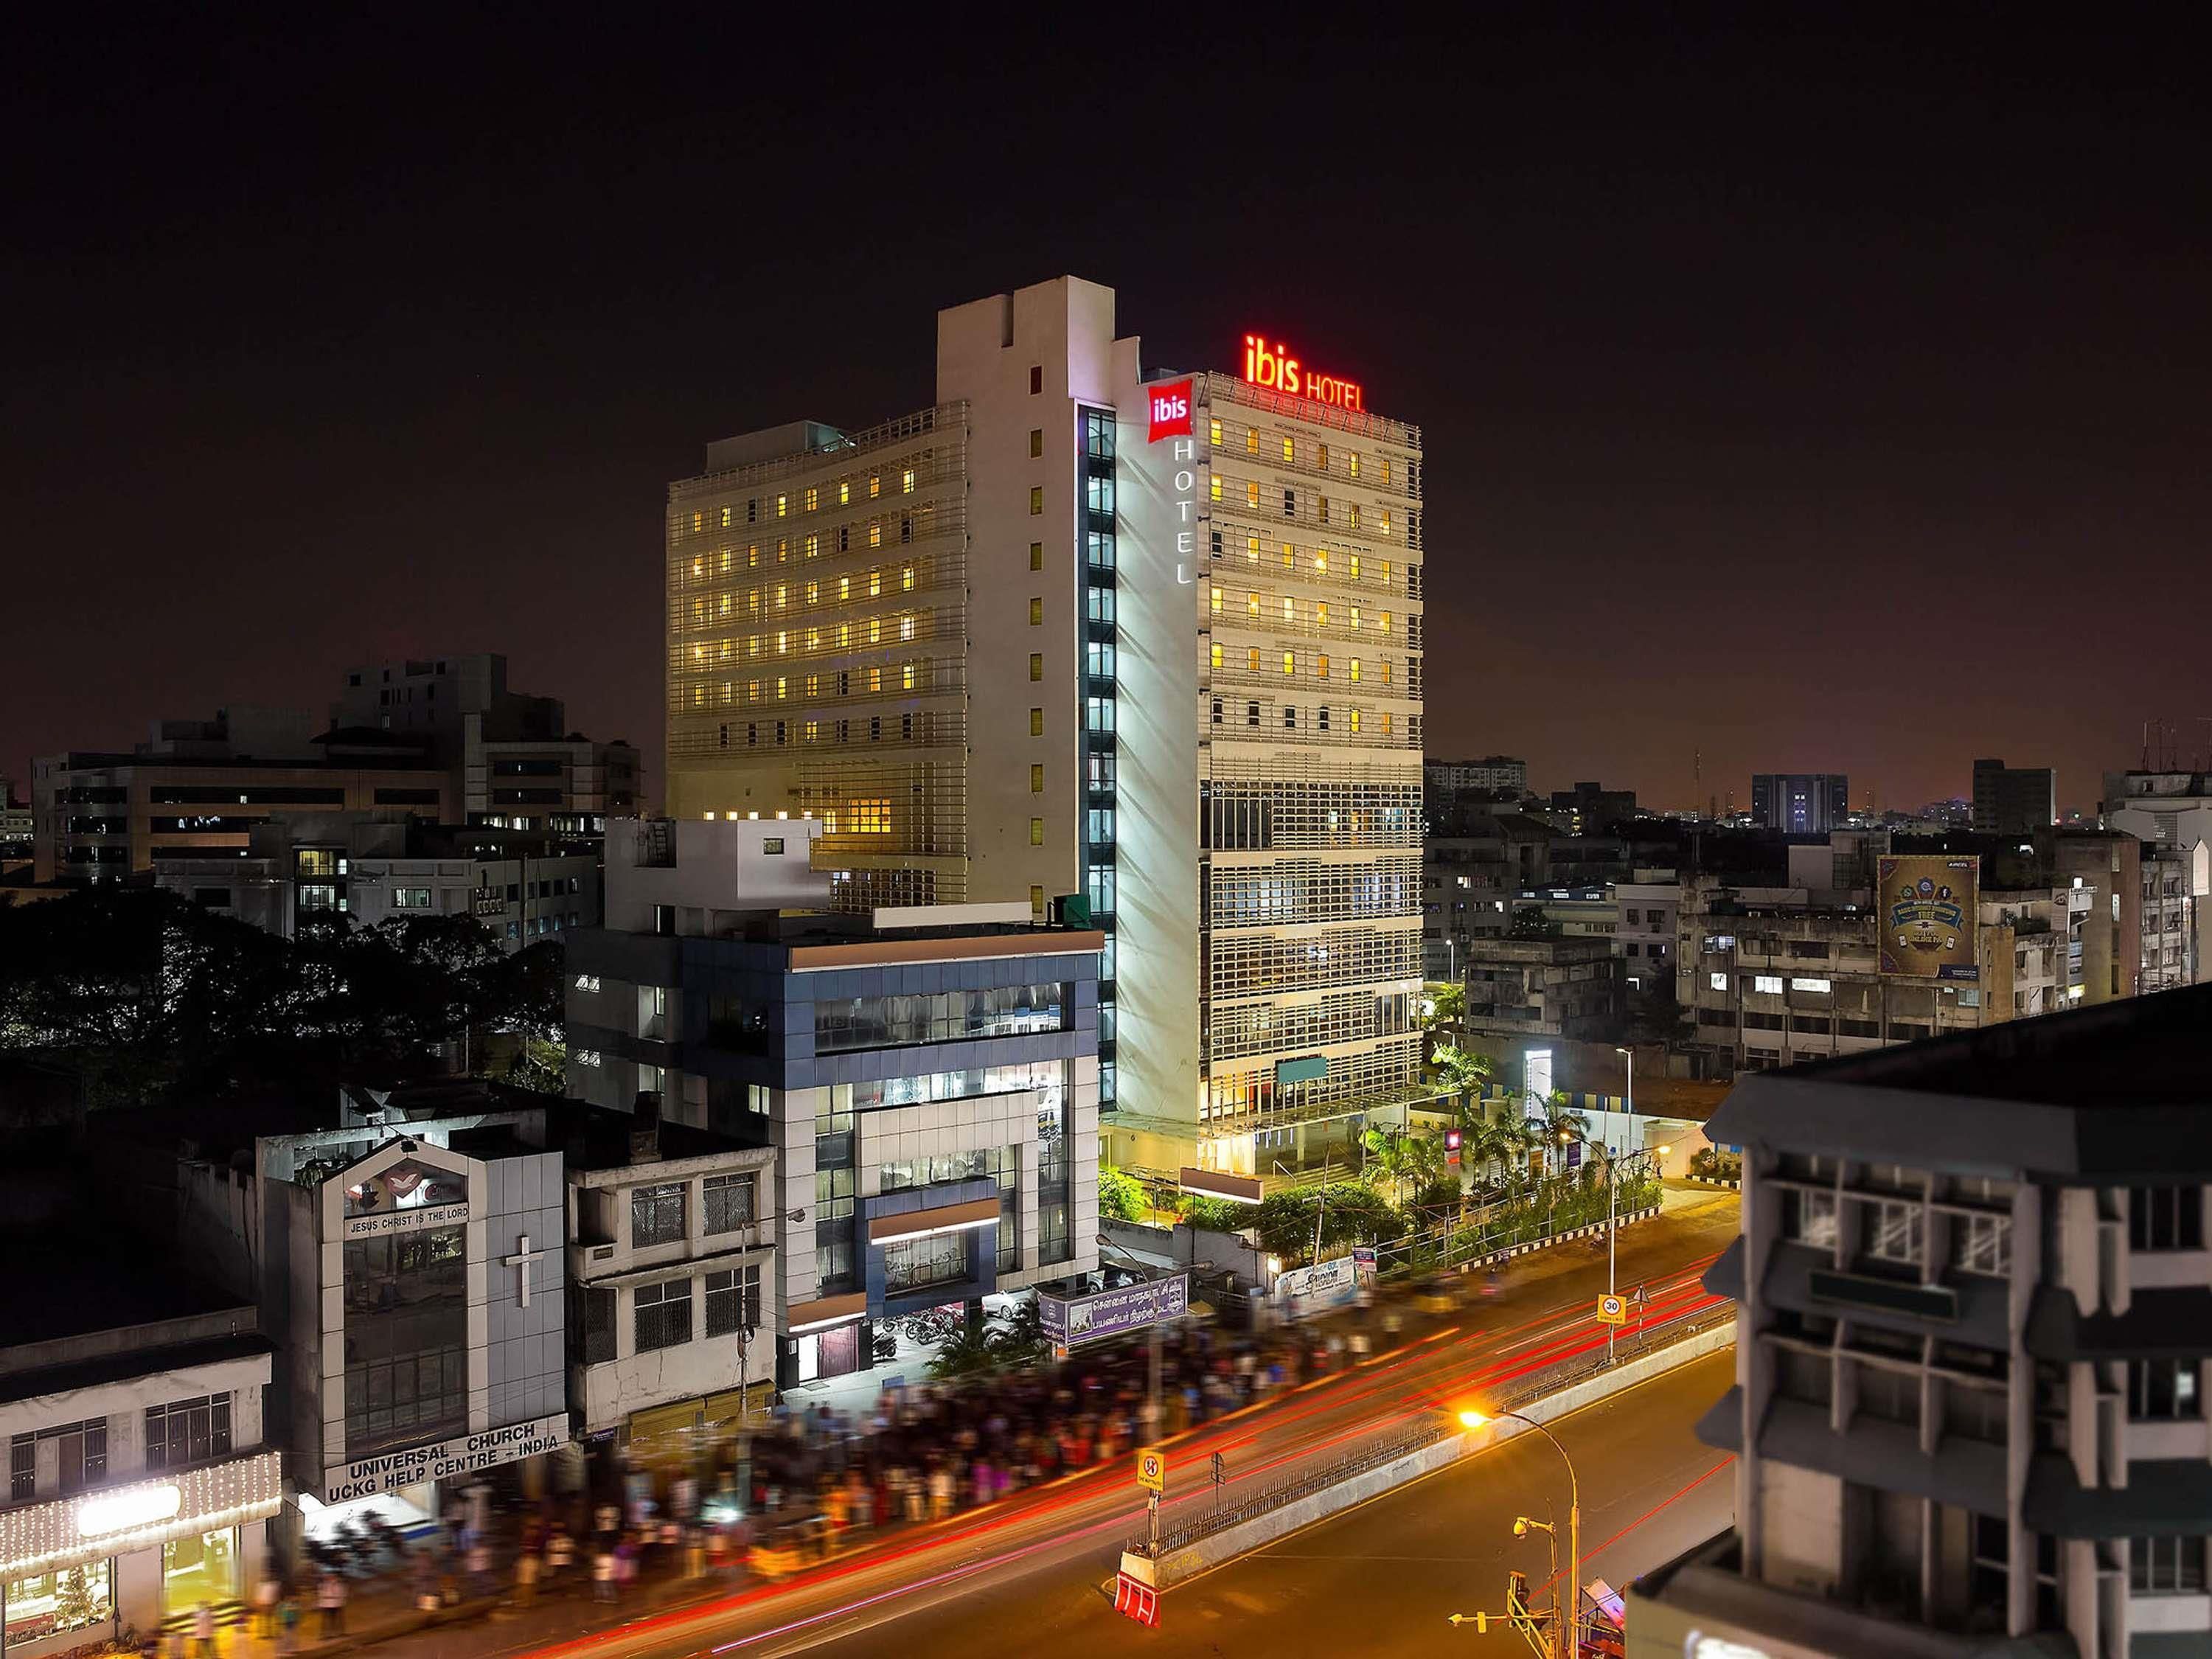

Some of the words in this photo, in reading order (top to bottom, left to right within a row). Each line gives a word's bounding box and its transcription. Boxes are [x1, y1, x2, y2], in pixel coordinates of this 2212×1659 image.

[1245, 335, 1299, 393] ibis
[1307, 372, 1364, 411] HOTEL
[1154, 394, 1187, 422] ibis
[1175, 439, 1193, 585] HOTEL
[351, 1220, 378, 1234] JESUS
[382, 1216, 412, 1228] CHRIST
[416, 1214, 424, 1223] IS
[428, 1211, 444, 1222] THE
[448, 1208, 468, 1218] LORD
[1093, 1295, 1127, 1312] சென்னை
[1607, 1301, 1618, 1310] 30
[329, 1478, 377, 1502] UCKG
[385, 1467, 425, 1489] HELP
[434, 1450, 498, 1477] CENTRE
[518, 1435, 559, 1456] INDIA
[349, 1445, 449, 1479] UNIVERSAL
[467, 1423, 535, 1451] CHURCH
